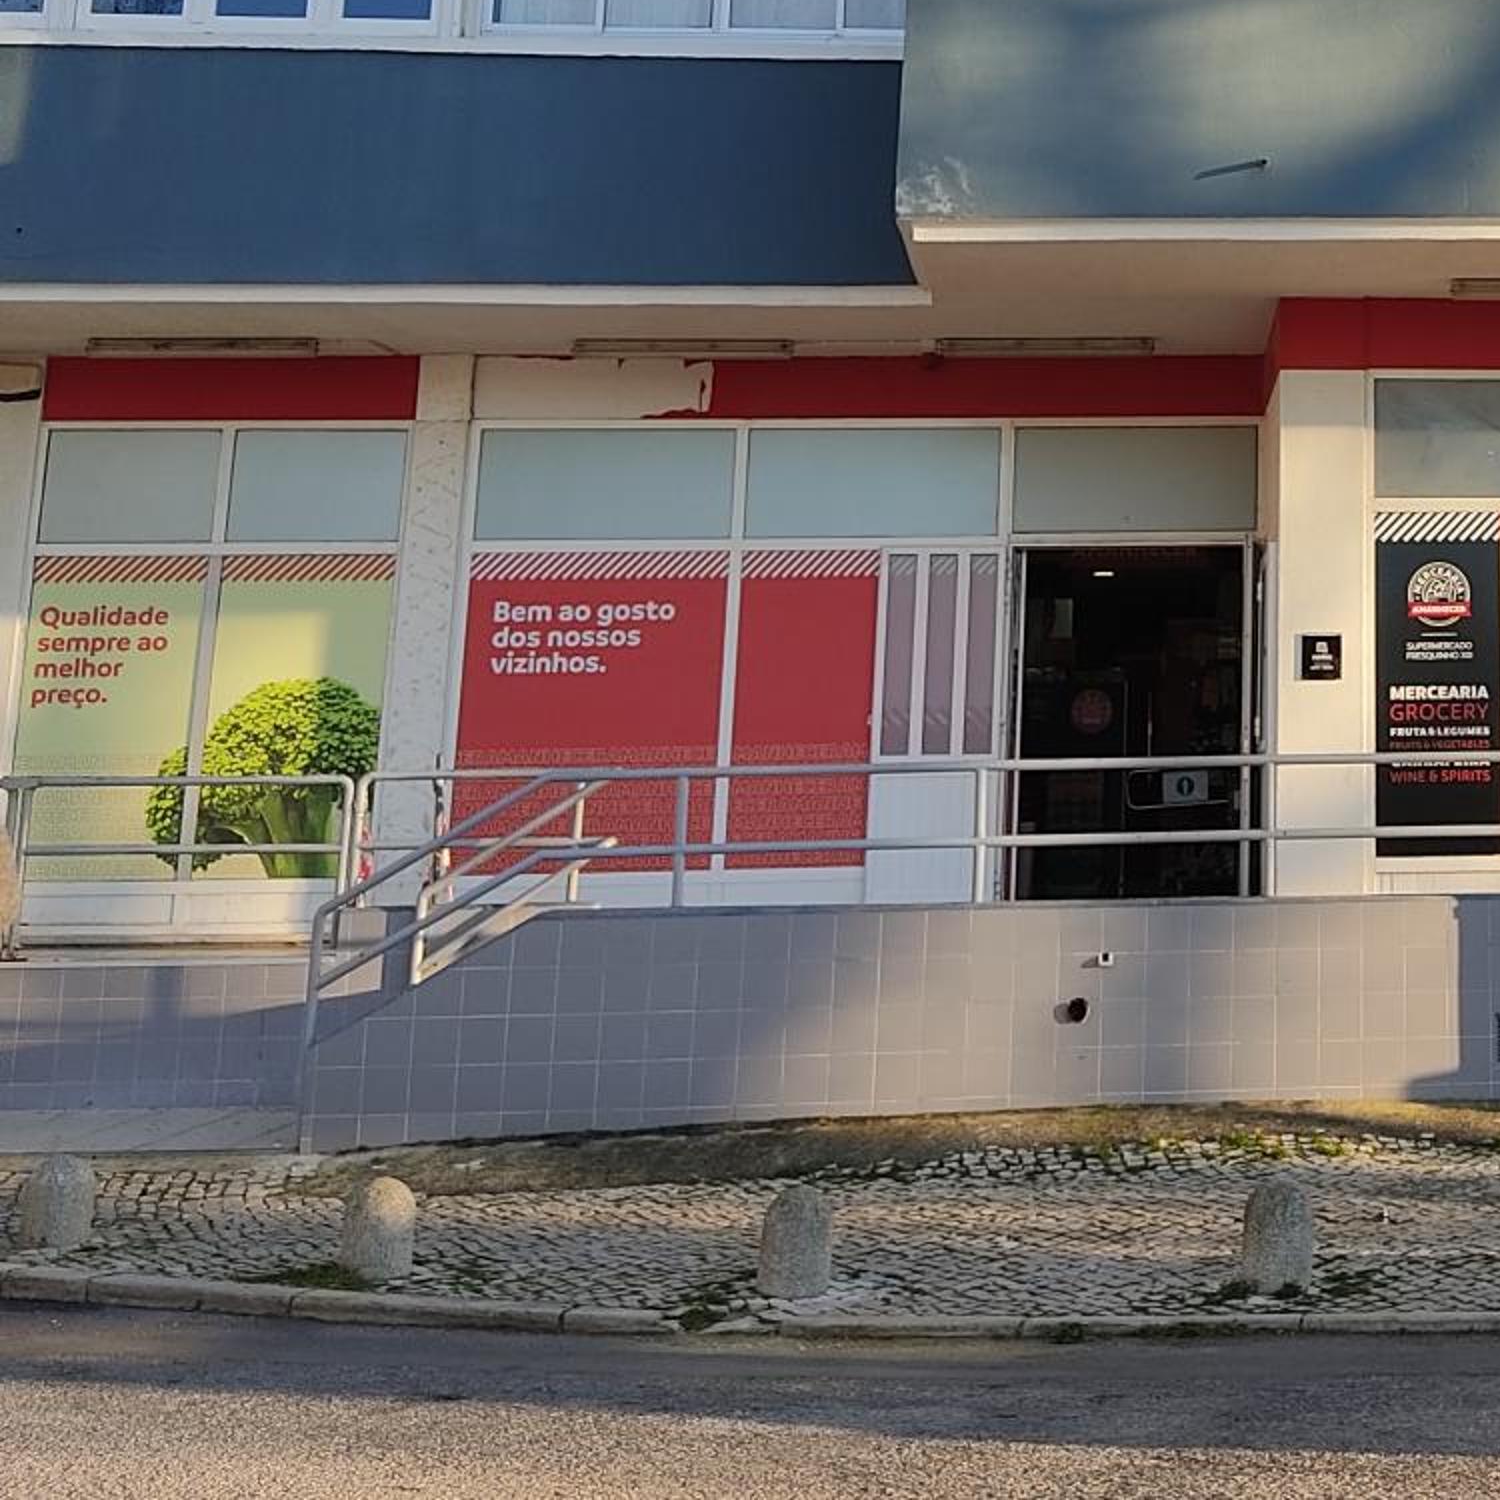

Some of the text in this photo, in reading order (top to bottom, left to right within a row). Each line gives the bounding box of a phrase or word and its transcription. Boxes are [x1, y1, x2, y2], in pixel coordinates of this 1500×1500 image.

[39, 605, 169, 630] Qualidade
[493, 601, 676, 626] Bem ao gosto
[37, 636, 168, 656] sempre ao
[491, 626, 641, 648] dos nossos
[34, 658, 123, 678] melhor
[490, 651, 607, 674] vizinhos.
[31, 688, 107, 709] preço.
[1389, 685, 1489, 700] MERCEARIA
[1389, 703, 1489, 721] GROCERY
[1389, 727, 1427, 737] FRUTA
[1437, 726, 1491, 736] LEGUMES
[1389, 770, 1425, 783] WINE
[1440, 769, 1491, 782] SPIRITS
